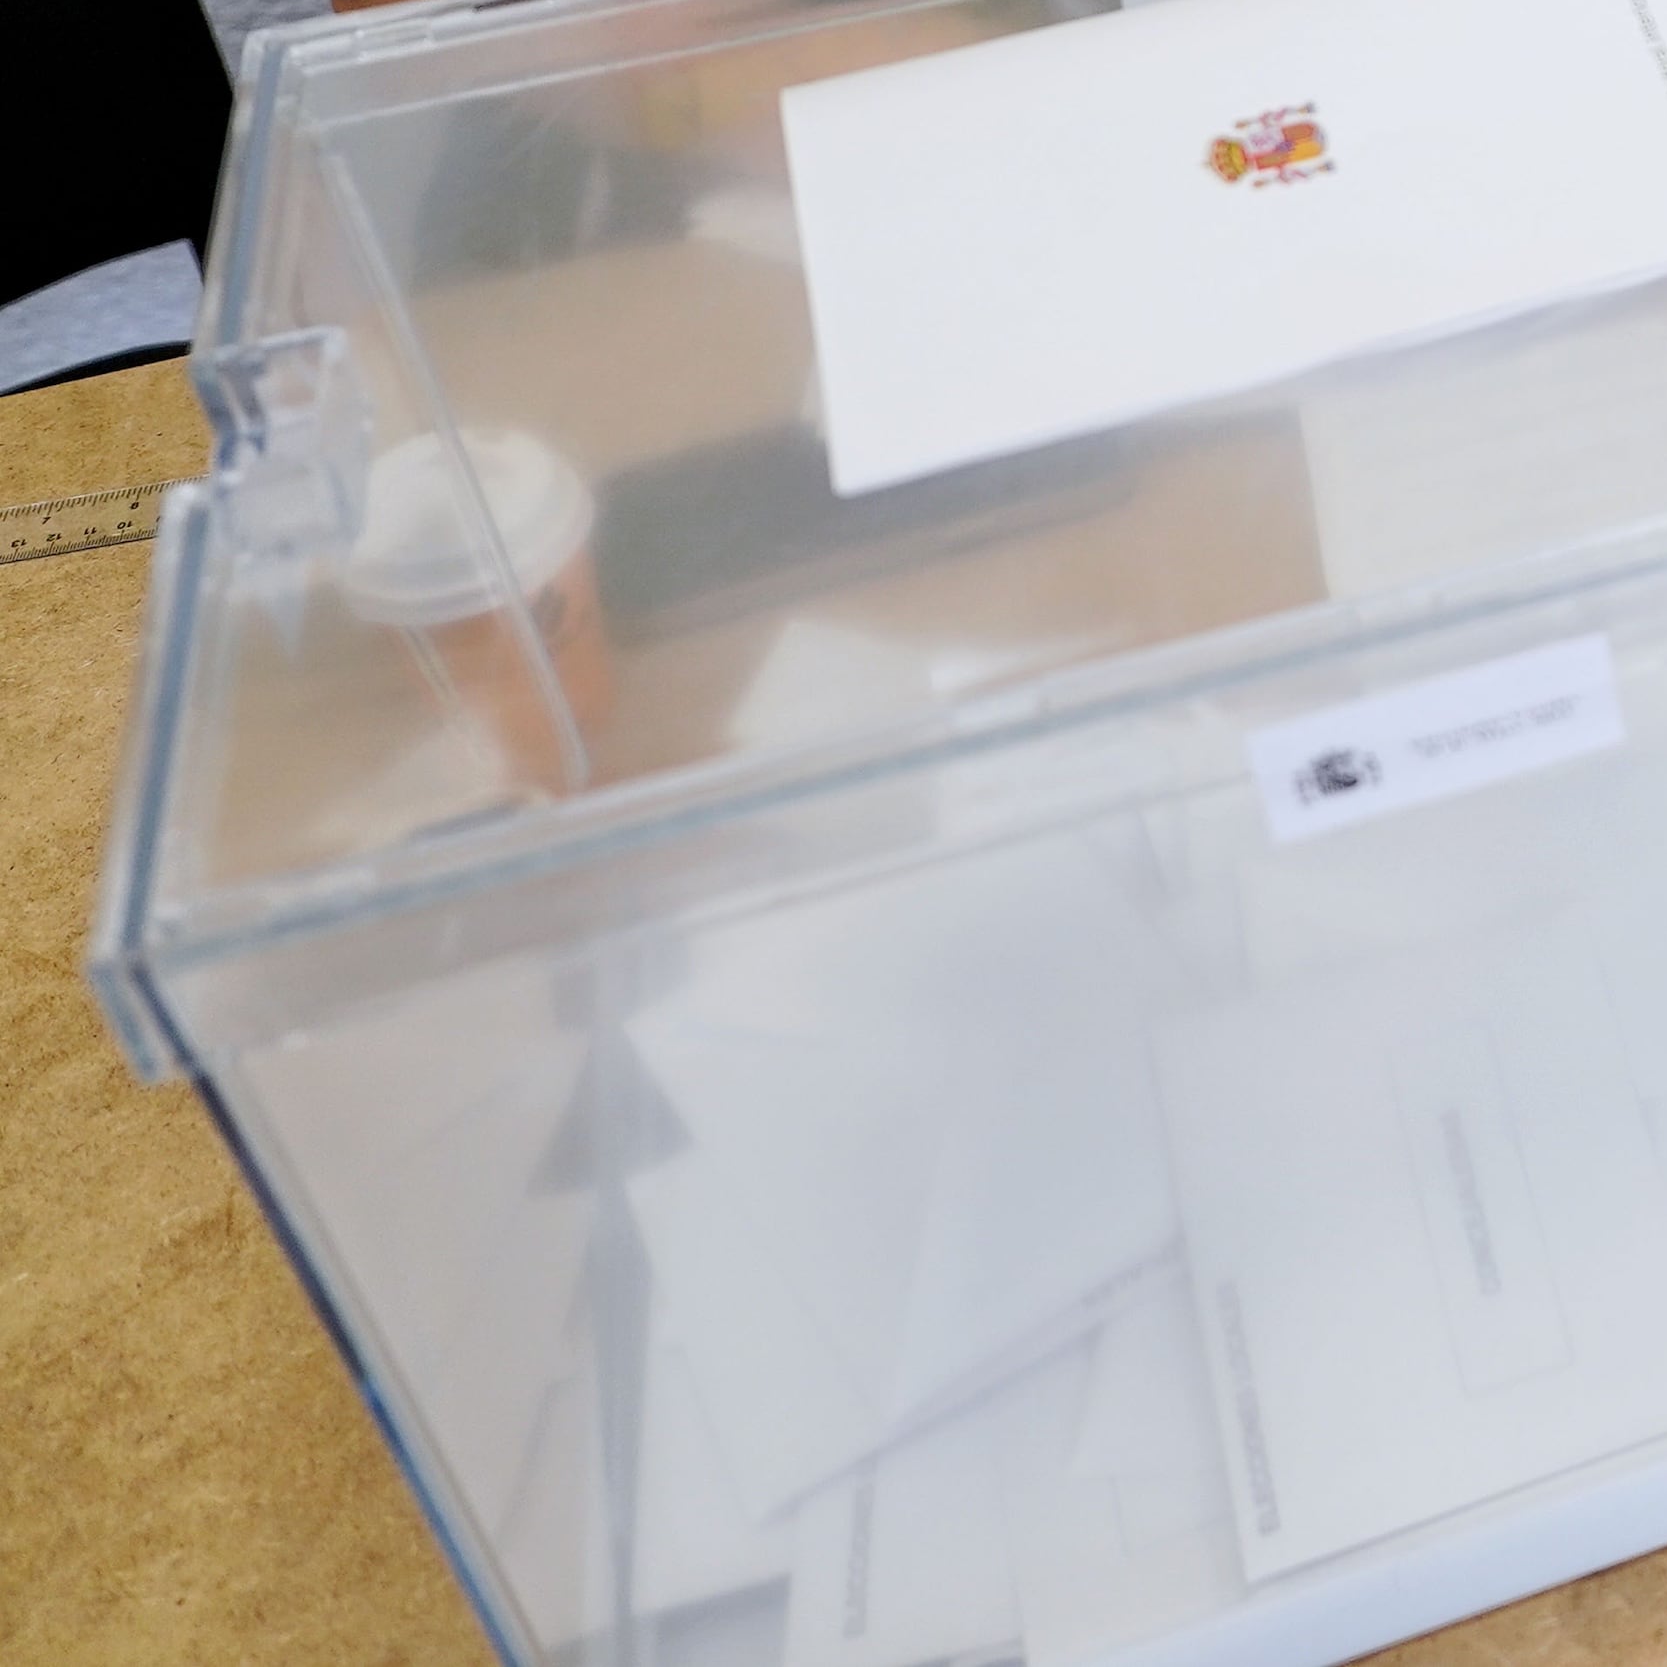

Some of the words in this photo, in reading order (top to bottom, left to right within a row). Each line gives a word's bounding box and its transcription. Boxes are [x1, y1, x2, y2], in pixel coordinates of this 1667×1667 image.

[116, 520, 133, 529] 10
[82, 526, 97, 535] 11
[45, 532, 62, 541] 12
[10, 538, 27, 547] 13
